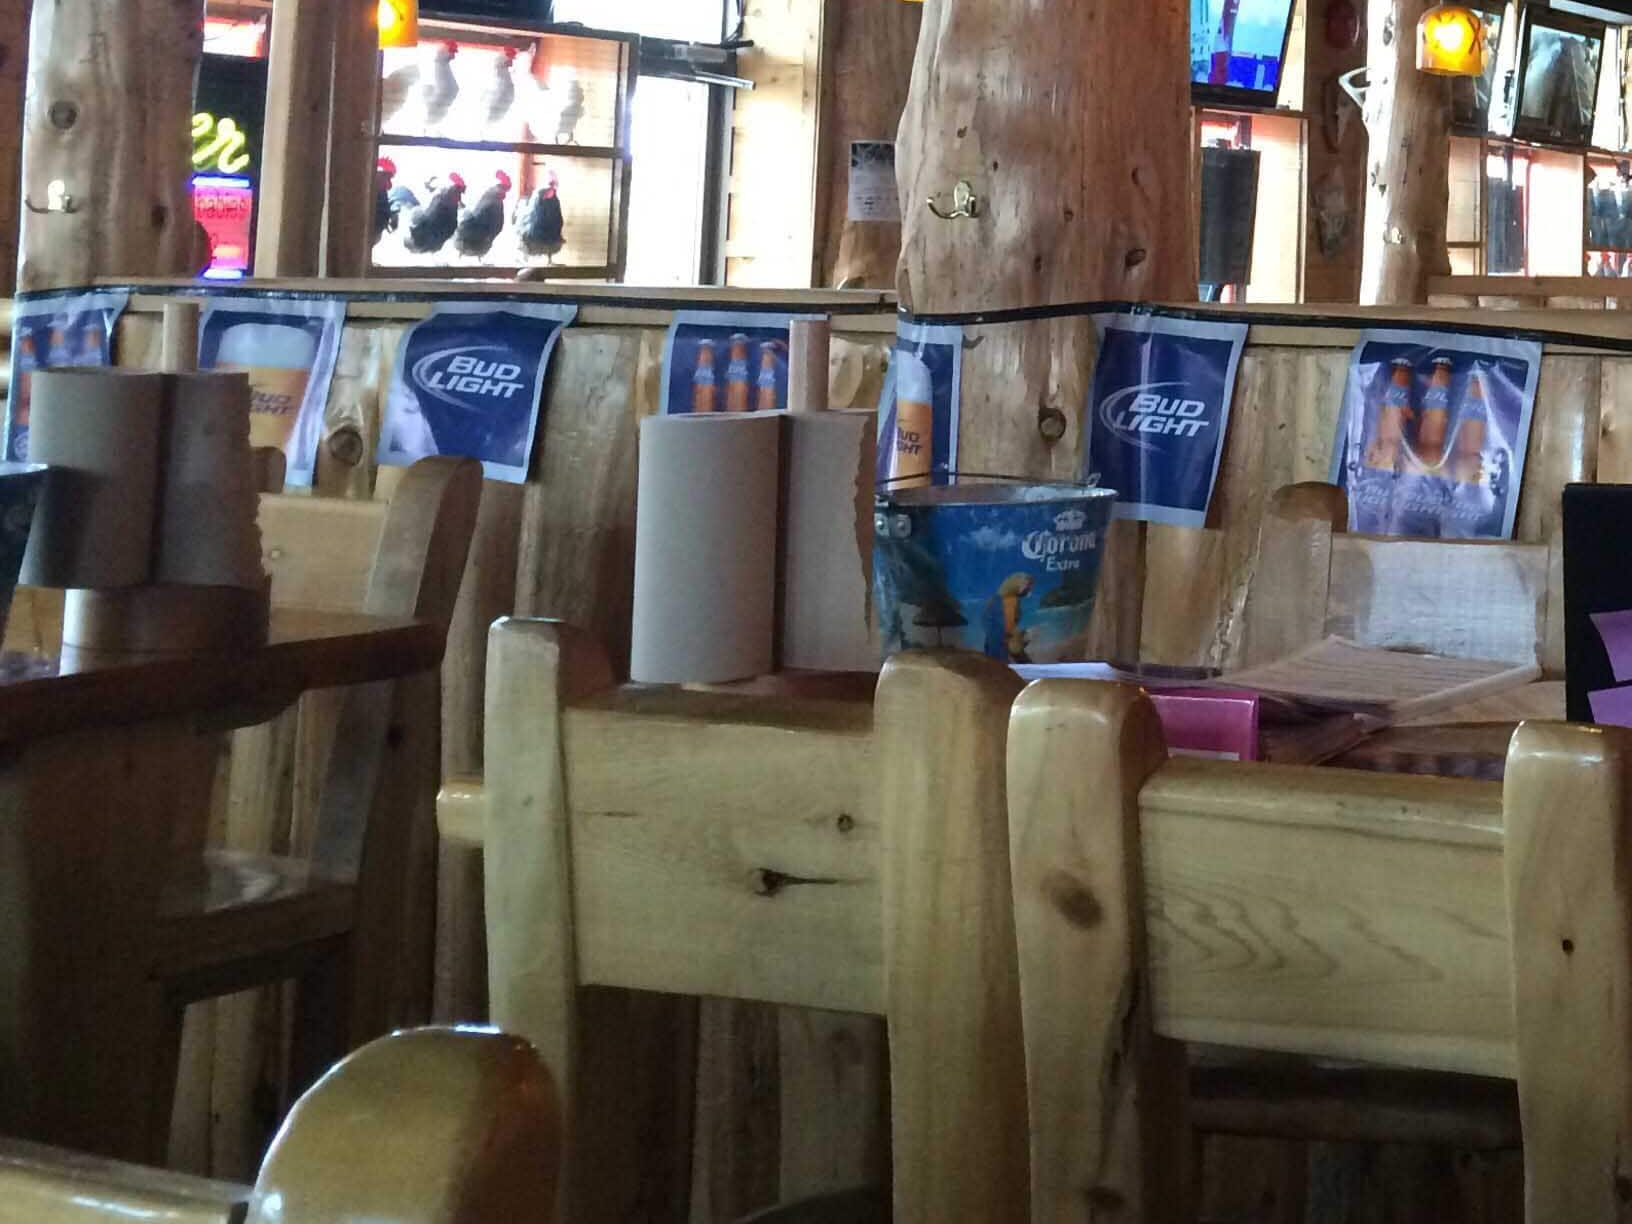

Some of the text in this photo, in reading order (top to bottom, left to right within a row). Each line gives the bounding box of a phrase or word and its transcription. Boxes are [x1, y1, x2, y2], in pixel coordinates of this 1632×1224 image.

[447, 355, 521, 380] BUD
[427, 371, 524, 398] LIGHT
[1128, 393, 1206, 417] BUD
[1113, 410, 1210, 437] LIGHT
[1022, 530, 1096, 562] Corona
[1046, 558, 1080, 572] Extra
